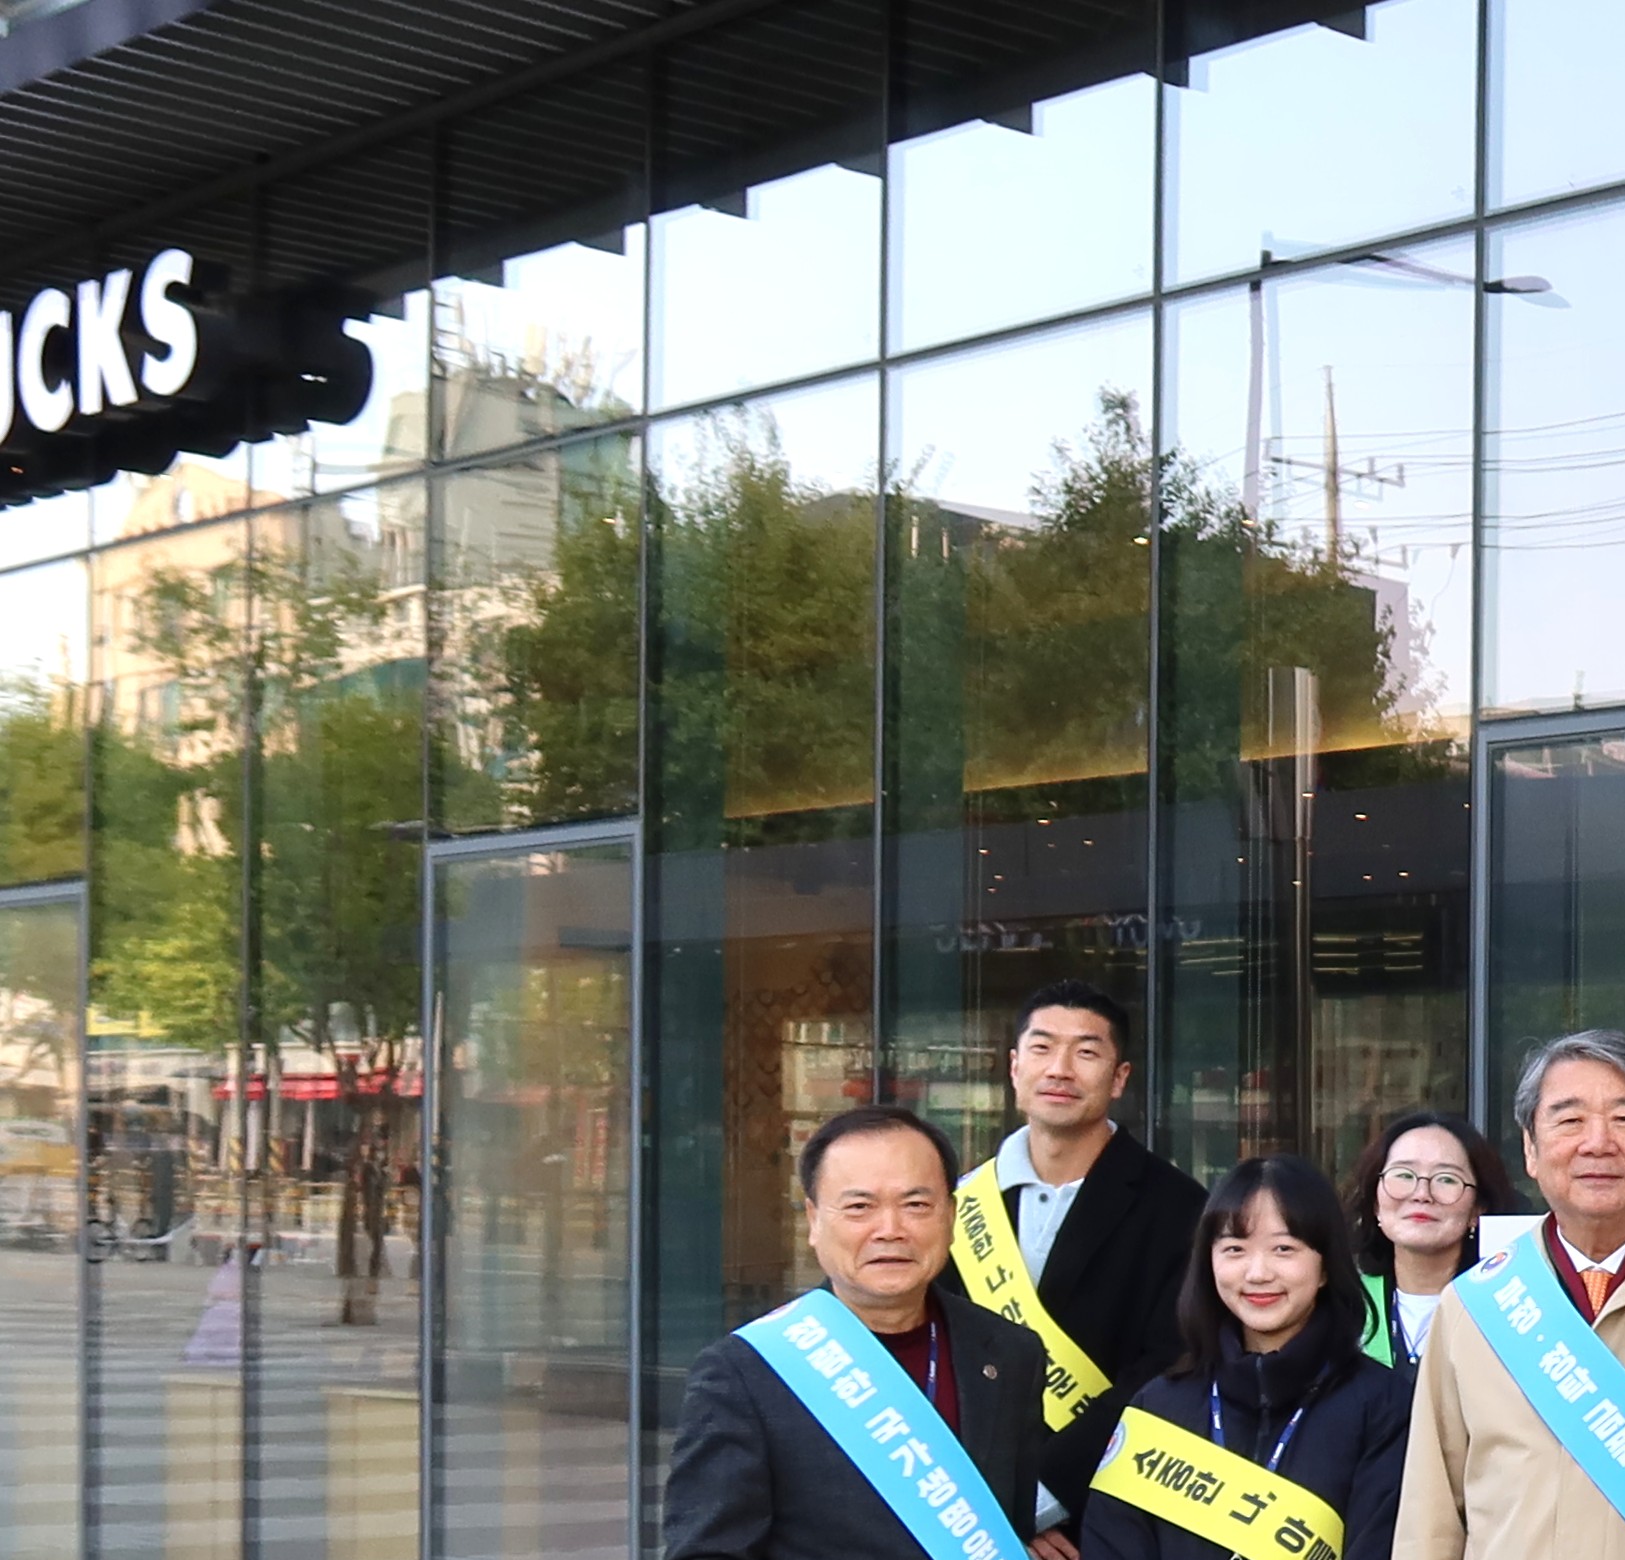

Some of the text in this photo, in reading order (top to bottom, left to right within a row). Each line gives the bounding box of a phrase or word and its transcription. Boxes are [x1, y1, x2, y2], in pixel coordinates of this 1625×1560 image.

[0, 247, 199, 445] CKS
[957, 1194, 995, 1265] 소중한
[783, 1315, 877, 1409] 청렴한
[1131, 1446, 1226, 1506] 소중한
[1229, 1490, 1279, 1526] 나,
